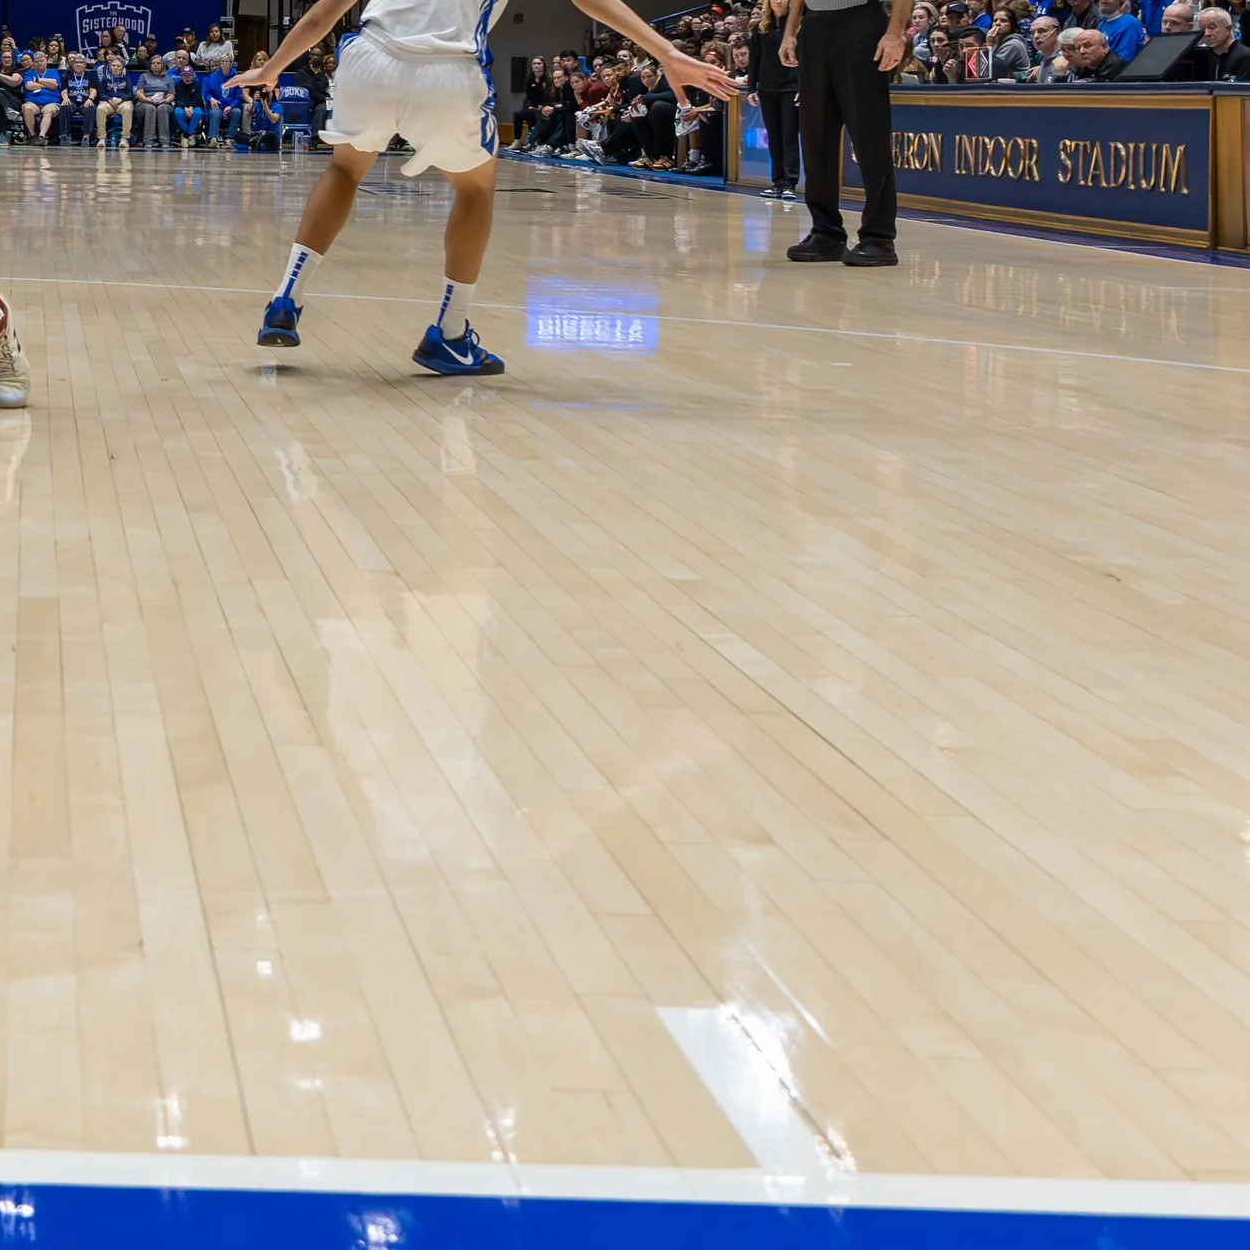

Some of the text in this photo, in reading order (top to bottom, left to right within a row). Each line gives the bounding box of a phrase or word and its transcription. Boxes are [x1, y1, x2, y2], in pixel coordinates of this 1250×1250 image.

[82, 17, 145, 34] SISTERHOOD
[284, 88, 306, 98] DUKE
[954, 134, 1040, 182] INDOOR
[1058, 138, 1190, 196] STADIUM
